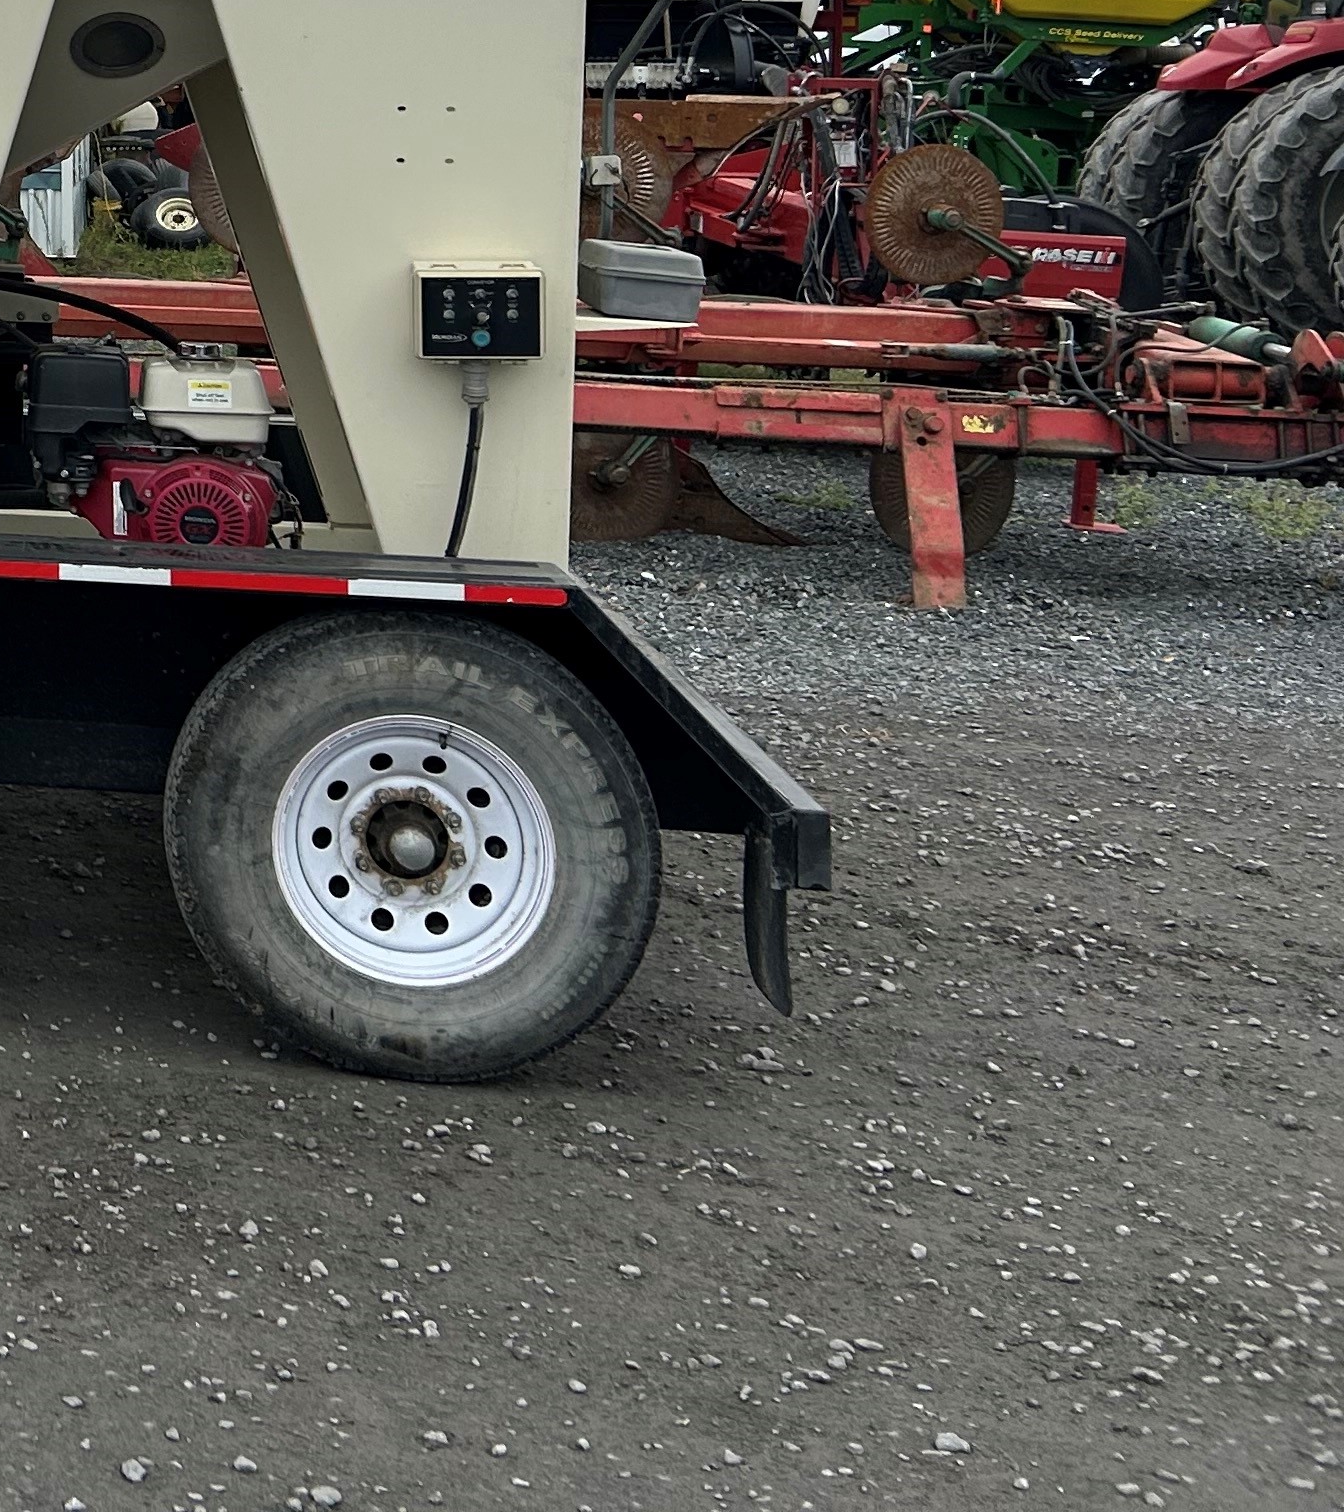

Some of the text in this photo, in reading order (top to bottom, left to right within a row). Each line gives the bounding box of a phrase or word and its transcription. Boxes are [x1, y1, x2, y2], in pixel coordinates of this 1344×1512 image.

[1048, 27, 1072, 36] CCS
[1075, 29, 1102, 38] Seed
[1103, 31, 1145, 42] Delivery
[342, 653, 492, 691] TRAIL
